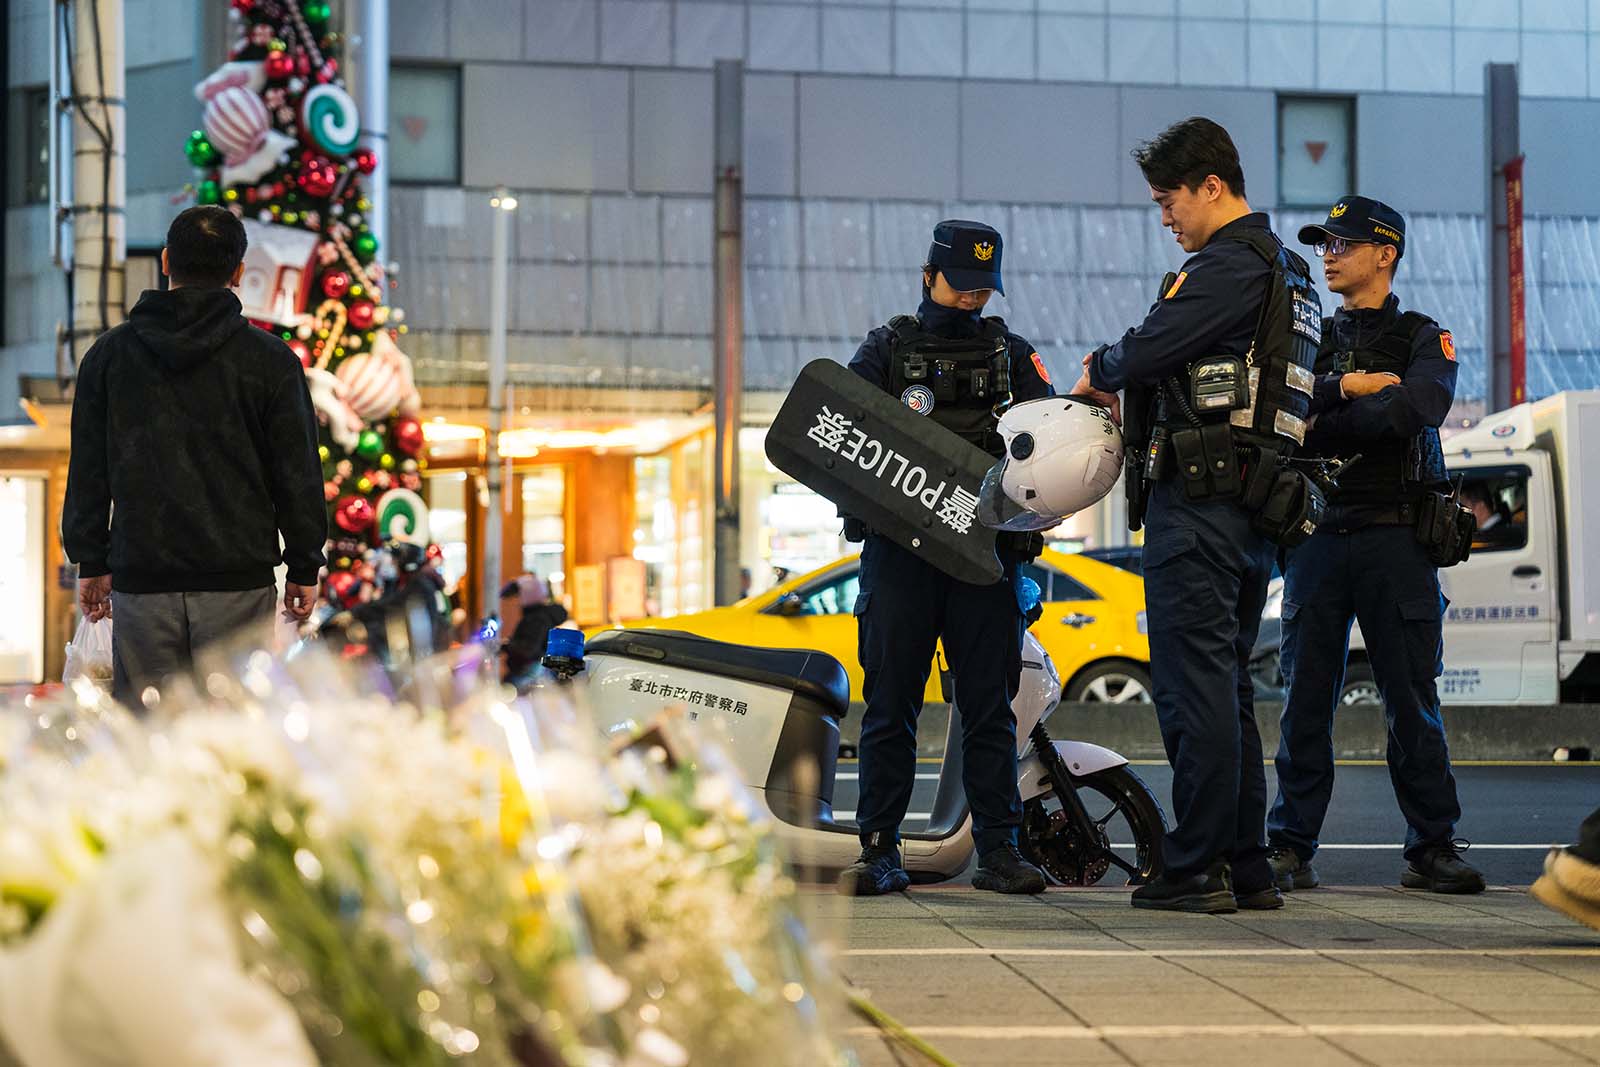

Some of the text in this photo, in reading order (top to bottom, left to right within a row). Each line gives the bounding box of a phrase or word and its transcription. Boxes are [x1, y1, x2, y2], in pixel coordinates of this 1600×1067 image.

[806, 405, 981, 535] 警 POLICE 察
[628, 678, 748, 716] 臺北市政府警察局
